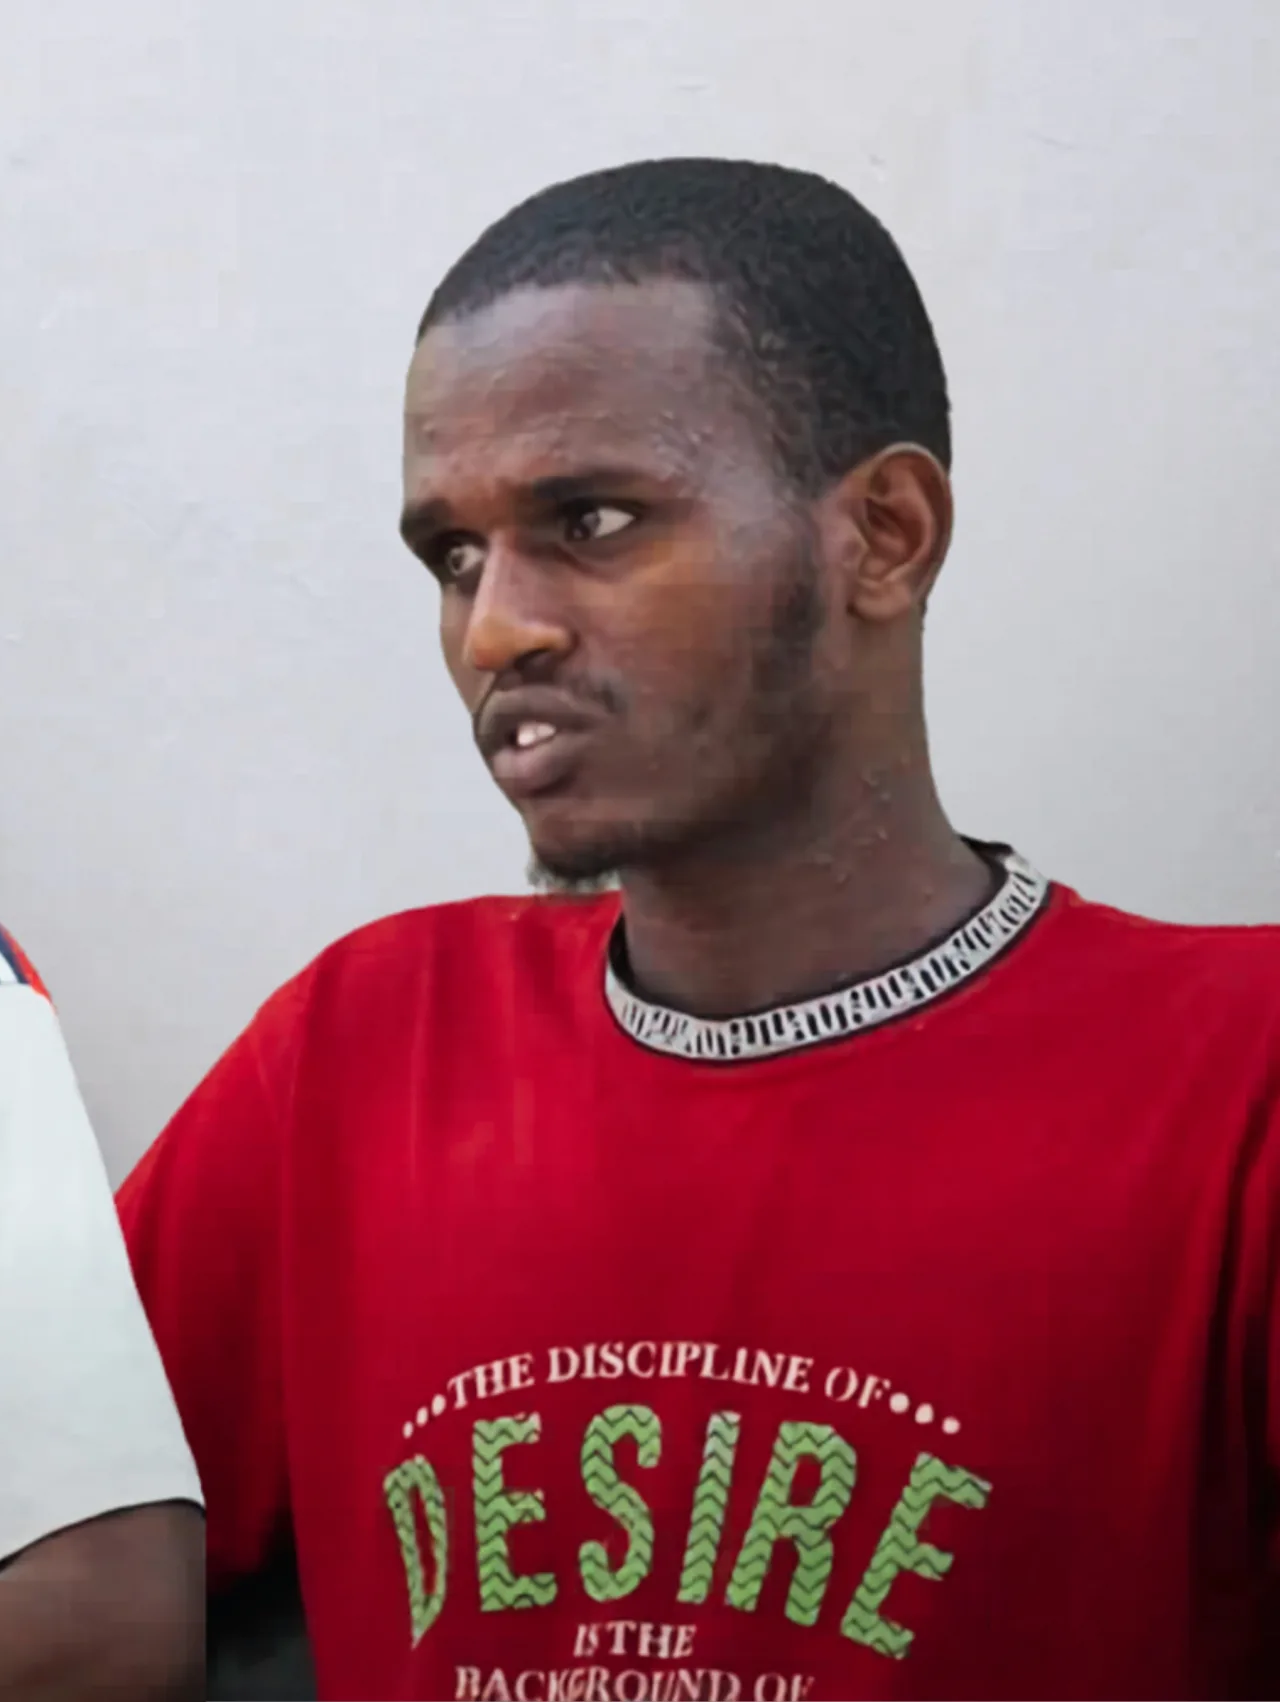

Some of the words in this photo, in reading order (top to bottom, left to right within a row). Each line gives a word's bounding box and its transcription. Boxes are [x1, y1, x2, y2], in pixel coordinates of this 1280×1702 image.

[447, 1353, 535, 1408] THE
[546, 1341, 814, 1394] DISCIPLINE
[824, 1367, 891, 1407] OF
[382, 1403, 993, 1660] DESIRE
[604, 1620, 697, 1659] THE
[455, 1666, 742, 1702] BACKGROUND
[753, 1673, 816, 1702] OF
